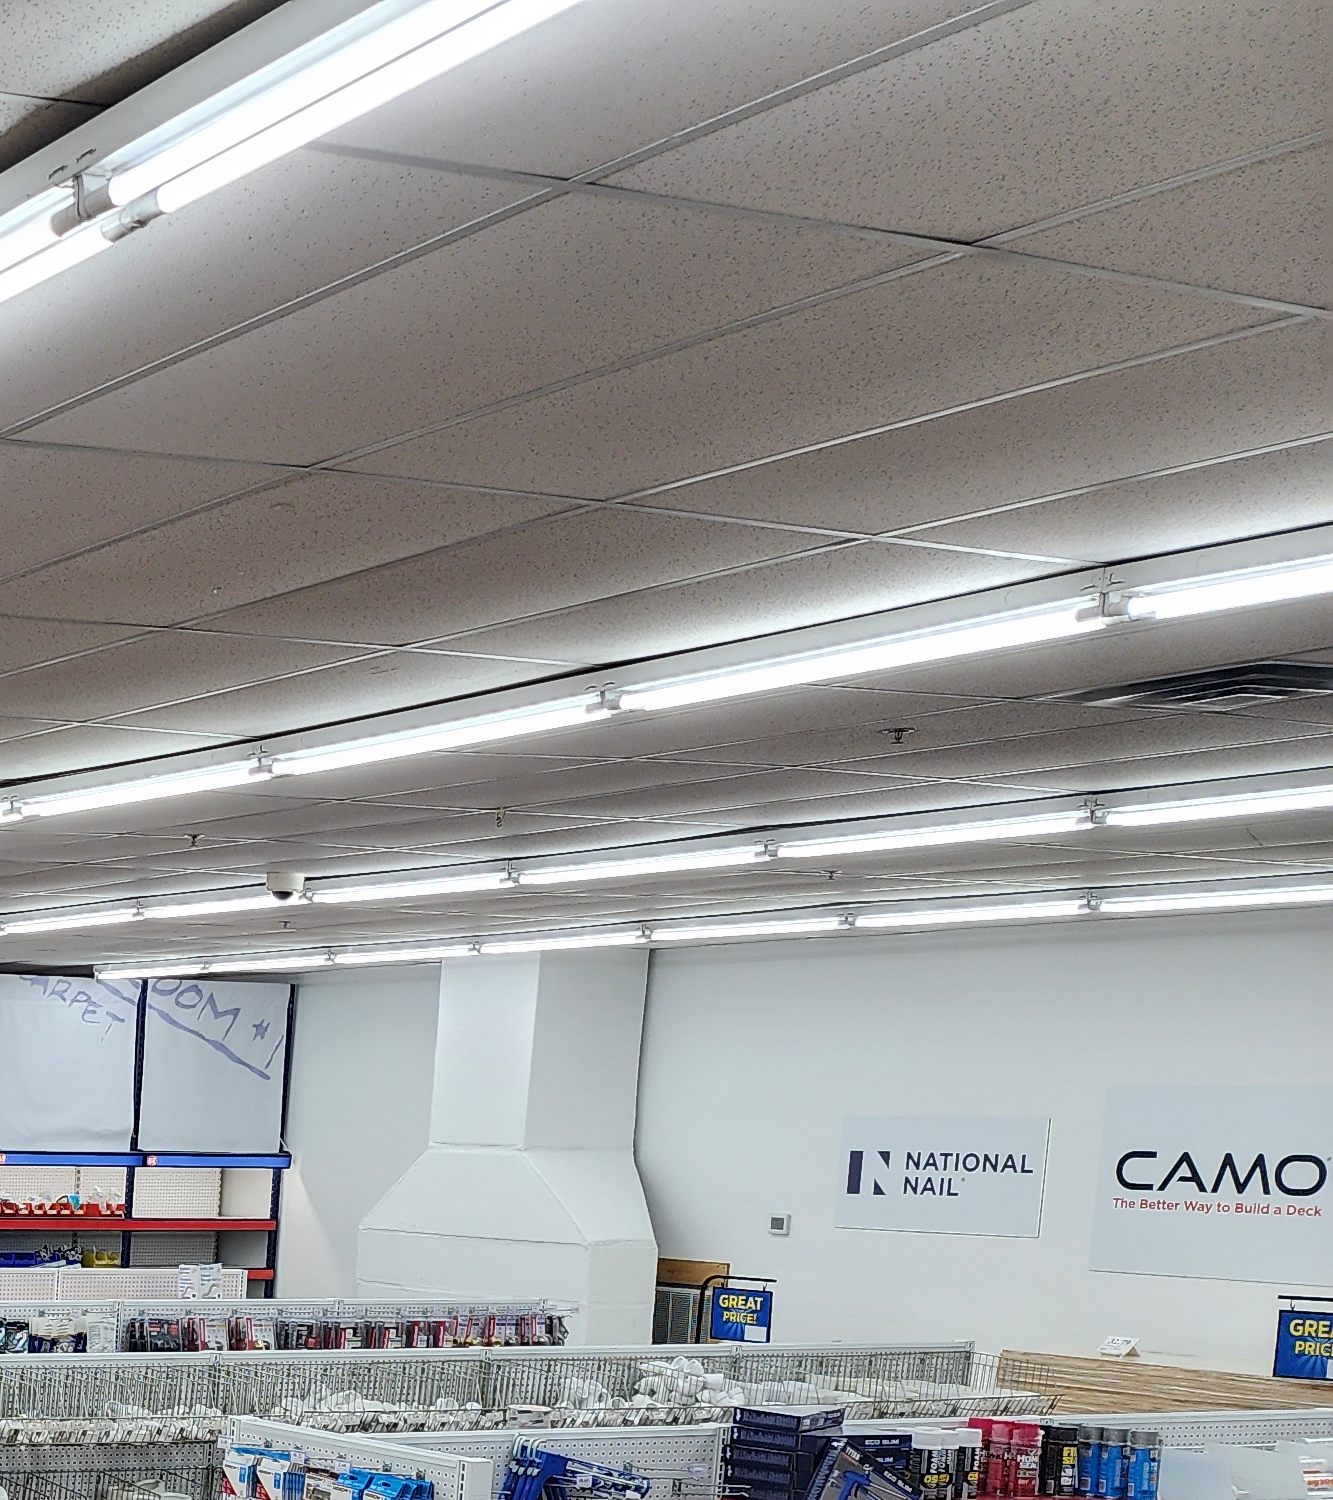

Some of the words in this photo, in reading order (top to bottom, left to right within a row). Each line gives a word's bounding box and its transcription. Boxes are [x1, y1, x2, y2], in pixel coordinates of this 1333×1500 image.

[904, 1151, 1034, 1175] NATIONAL
[1115, 1150, 1327, 1197] CAMO
[903, 1176, 960, 1198] NAIL
[1113, 1198, 1136, 1212] The
[1139, 1198, 1180, 1213] Better
[1183, 1199, 1213, 1215] Way
[1215, 1201, 1231, 1214] to
[1234, 1201, 1270, 1216] Build
[1273, 1206, 1282, 1217] a
[1286, 1204, 1323, 1218] Deck
[718, 1294, 764, 1311] GREAT
[722, 1311, 758, 1325] PRICE!
